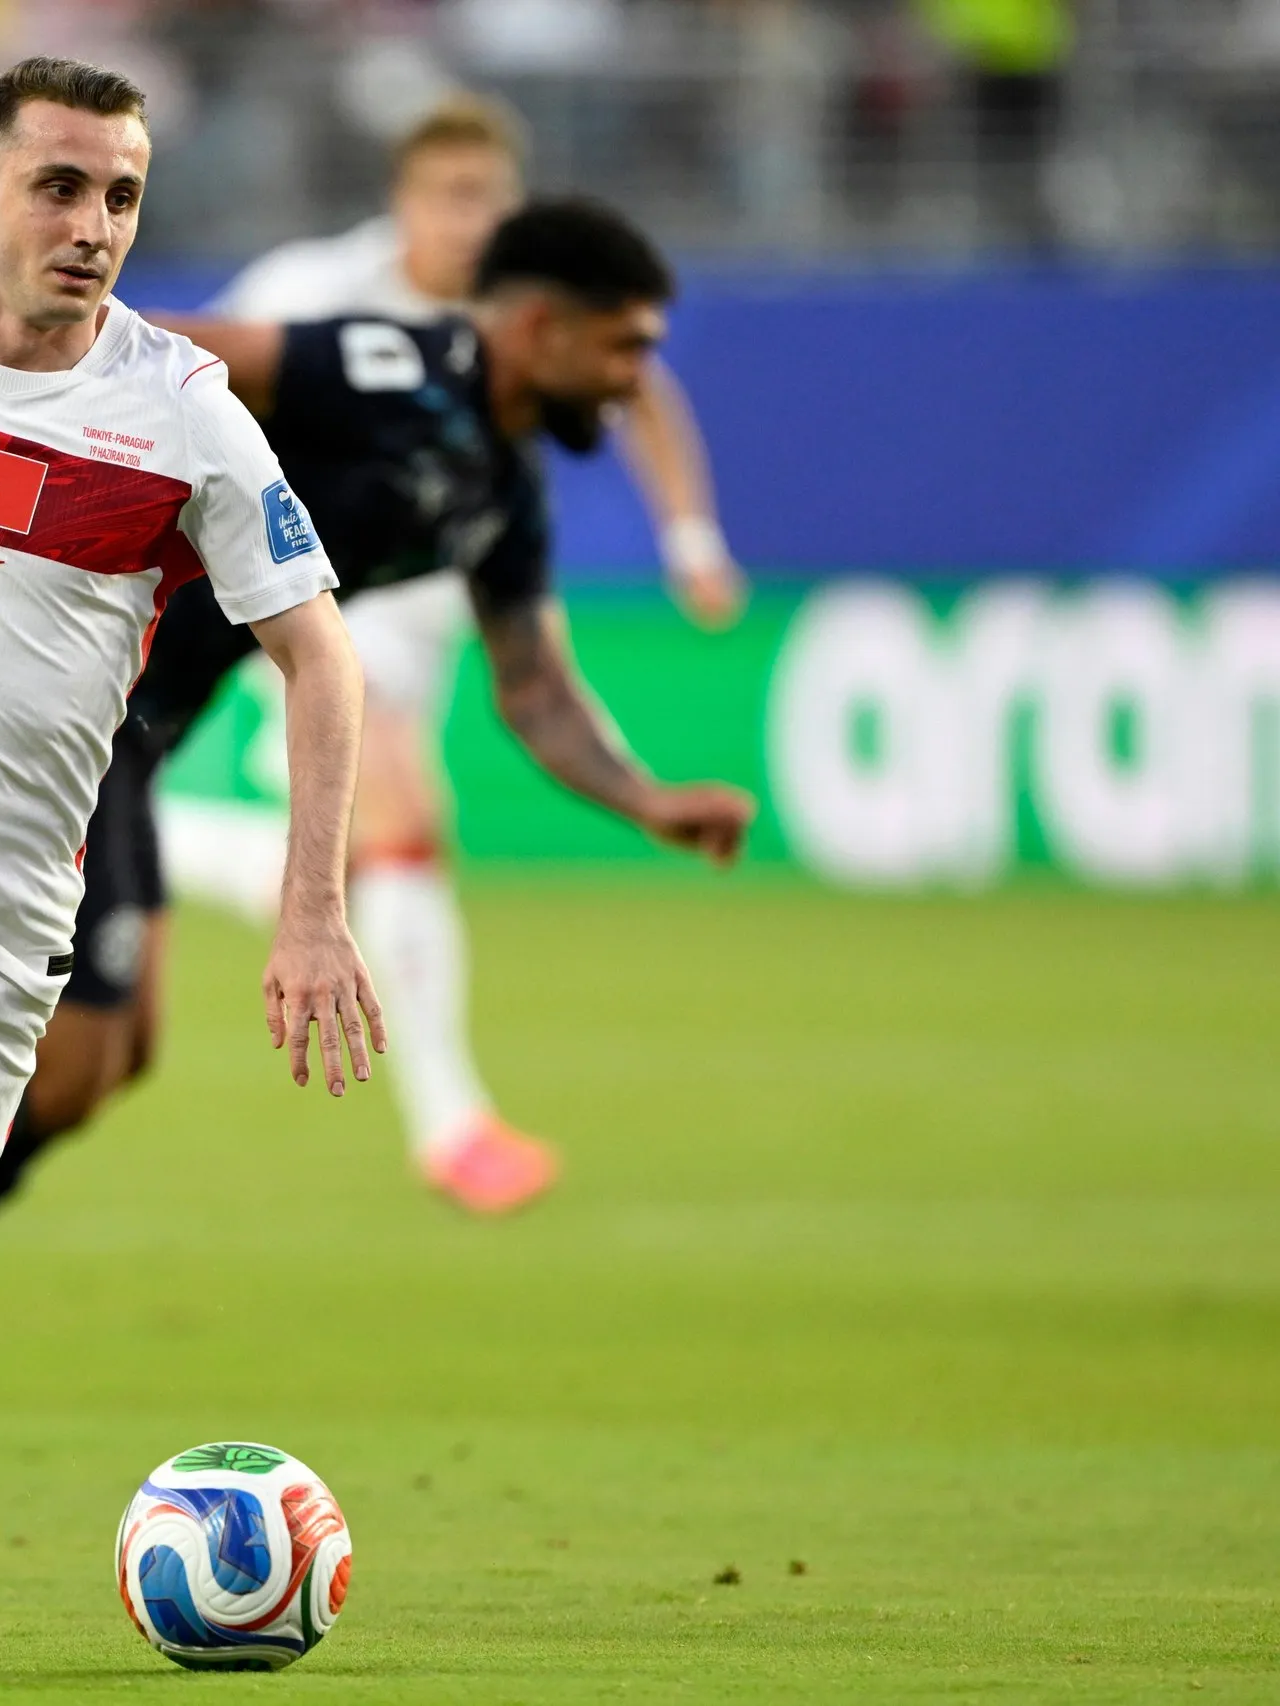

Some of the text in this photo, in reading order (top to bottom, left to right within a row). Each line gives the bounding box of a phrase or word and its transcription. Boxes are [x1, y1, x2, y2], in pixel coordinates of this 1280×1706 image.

[89, 445, 97, 457] 19
[126, 453, 141, 467] 2026
[291, 537, 309, 548] FIFA
